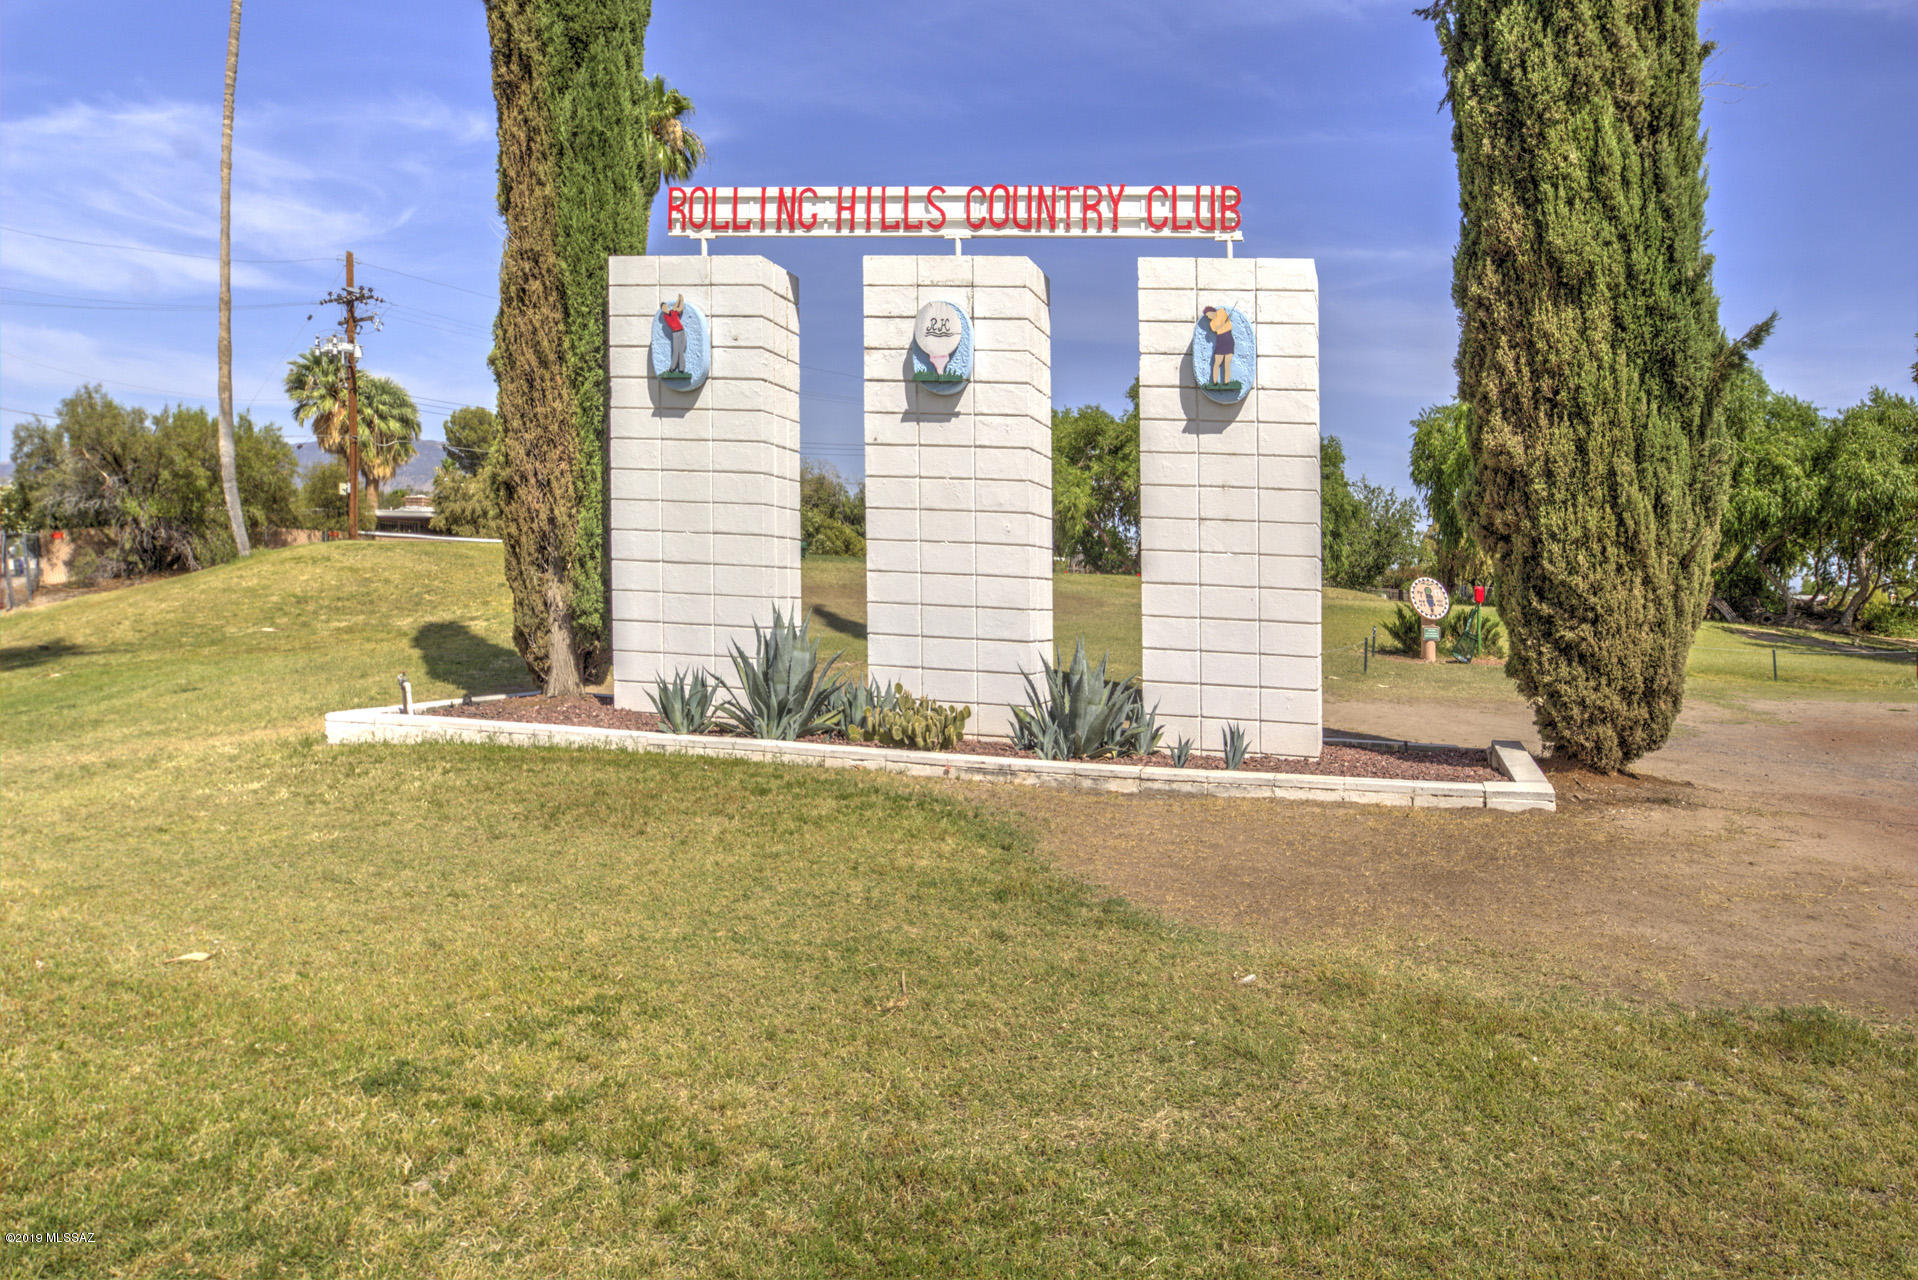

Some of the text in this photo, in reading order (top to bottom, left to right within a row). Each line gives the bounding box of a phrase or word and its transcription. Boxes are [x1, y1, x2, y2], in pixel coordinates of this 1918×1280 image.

[668, 184, 1242, 231] ROLLING HILLS COUNTRY CLUB
